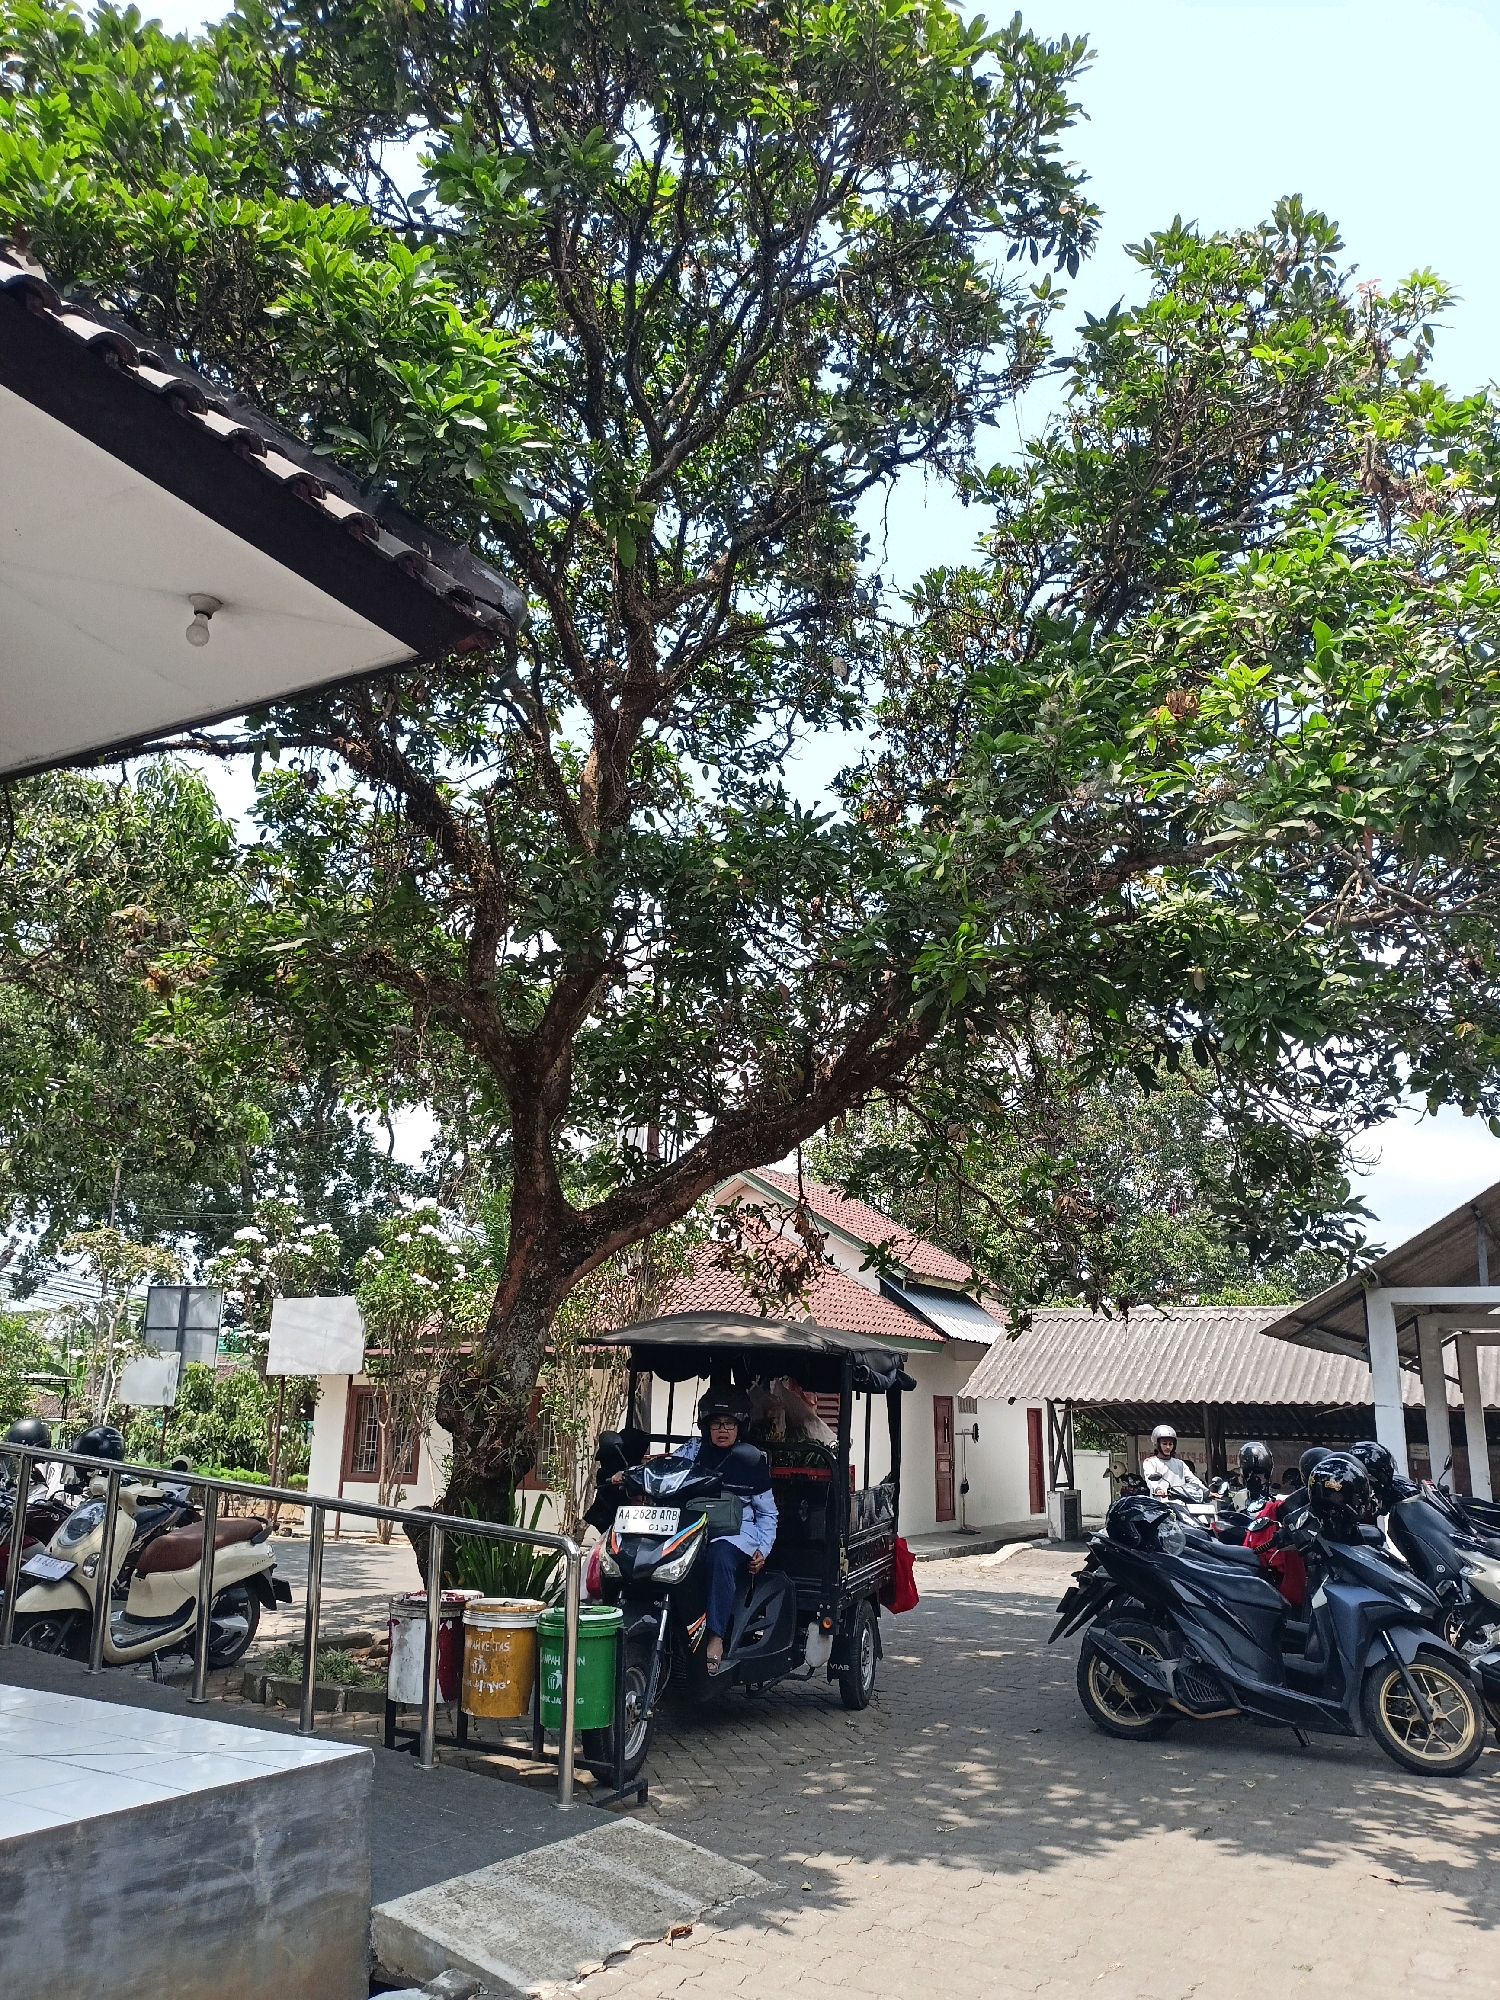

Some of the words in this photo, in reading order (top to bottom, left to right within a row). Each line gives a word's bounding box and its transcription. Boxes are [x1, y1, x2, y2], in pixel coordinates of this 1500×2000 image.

[619, 1509, 630, 1520] AA
[633, 1509, 657, 1520] 2628
[481, 1640, 510, 1652] KETAS
[830, 1663, 850, 1671] VIAR
